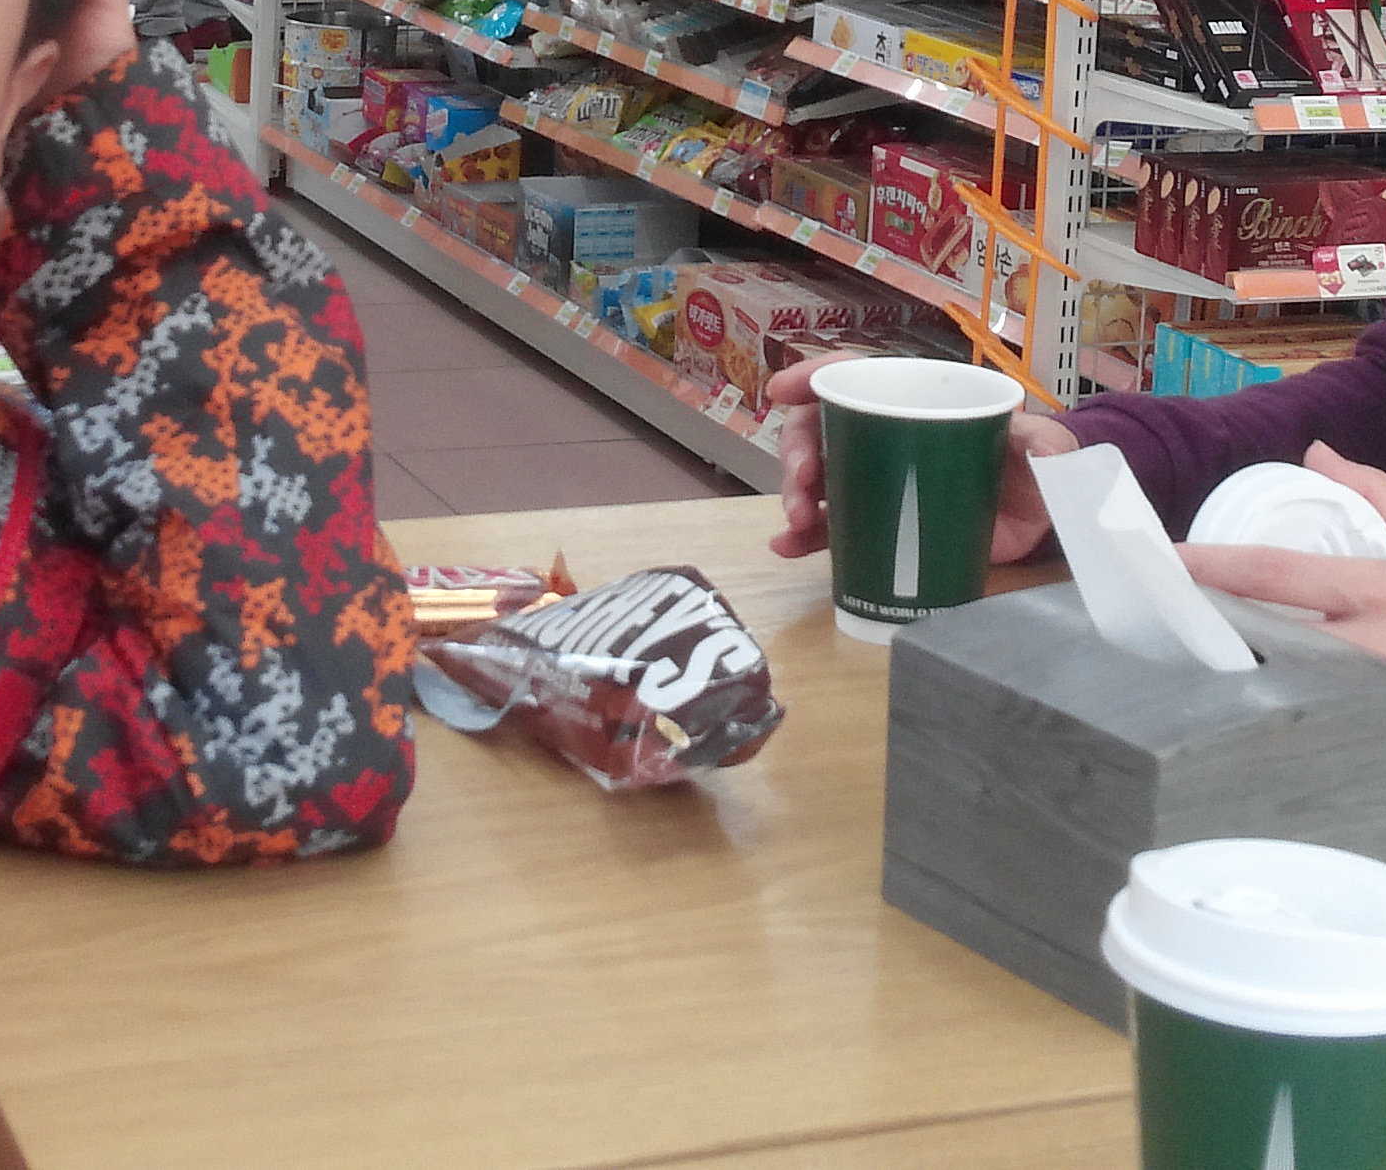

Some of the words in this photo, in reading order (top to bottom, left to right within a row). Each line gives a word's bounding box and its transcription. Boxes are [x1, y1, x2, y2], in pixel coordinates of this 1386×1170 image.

[876, 185, 928, 223] 후렌치파이
[1236, 186, 1259, 195] LOTTE
[1237, 197, 1326, 241] Binch
[843, 595, 879, 615] LOTTE
[878, 604, 927, 619] WORLD
